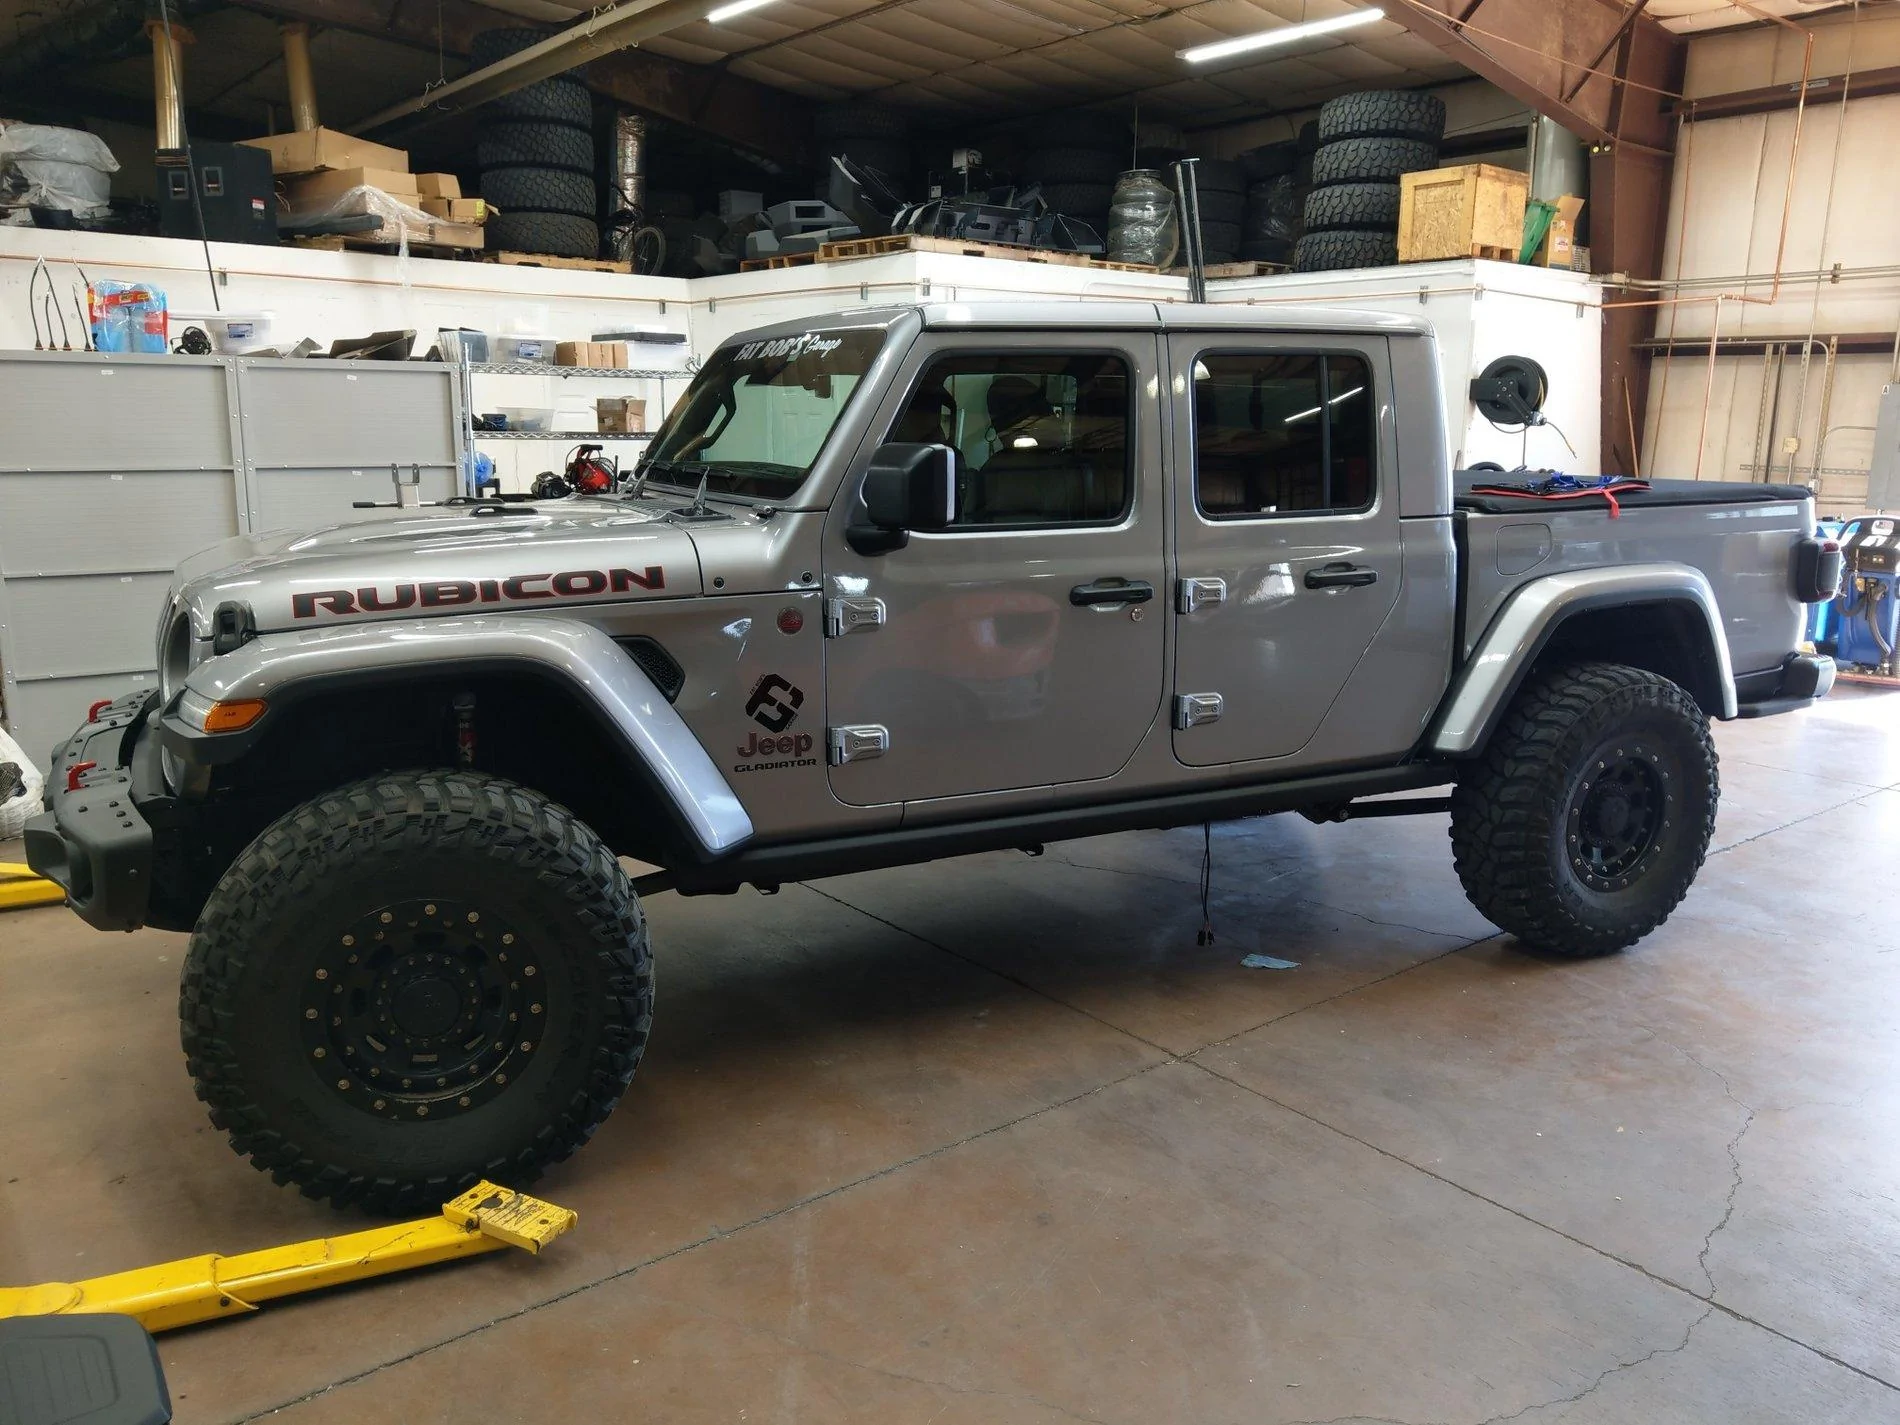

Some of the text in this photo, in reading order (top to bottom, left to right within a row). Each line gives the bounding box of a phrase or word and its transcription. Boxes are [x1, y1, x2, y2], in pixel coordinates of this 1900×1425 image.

[733, 341, 766, 361] FAT
[292, 565, 665, 619] RUBICON
[737, 732, 812, 757] Jeep
[734, 759, 816, 772] GLADIATOR
